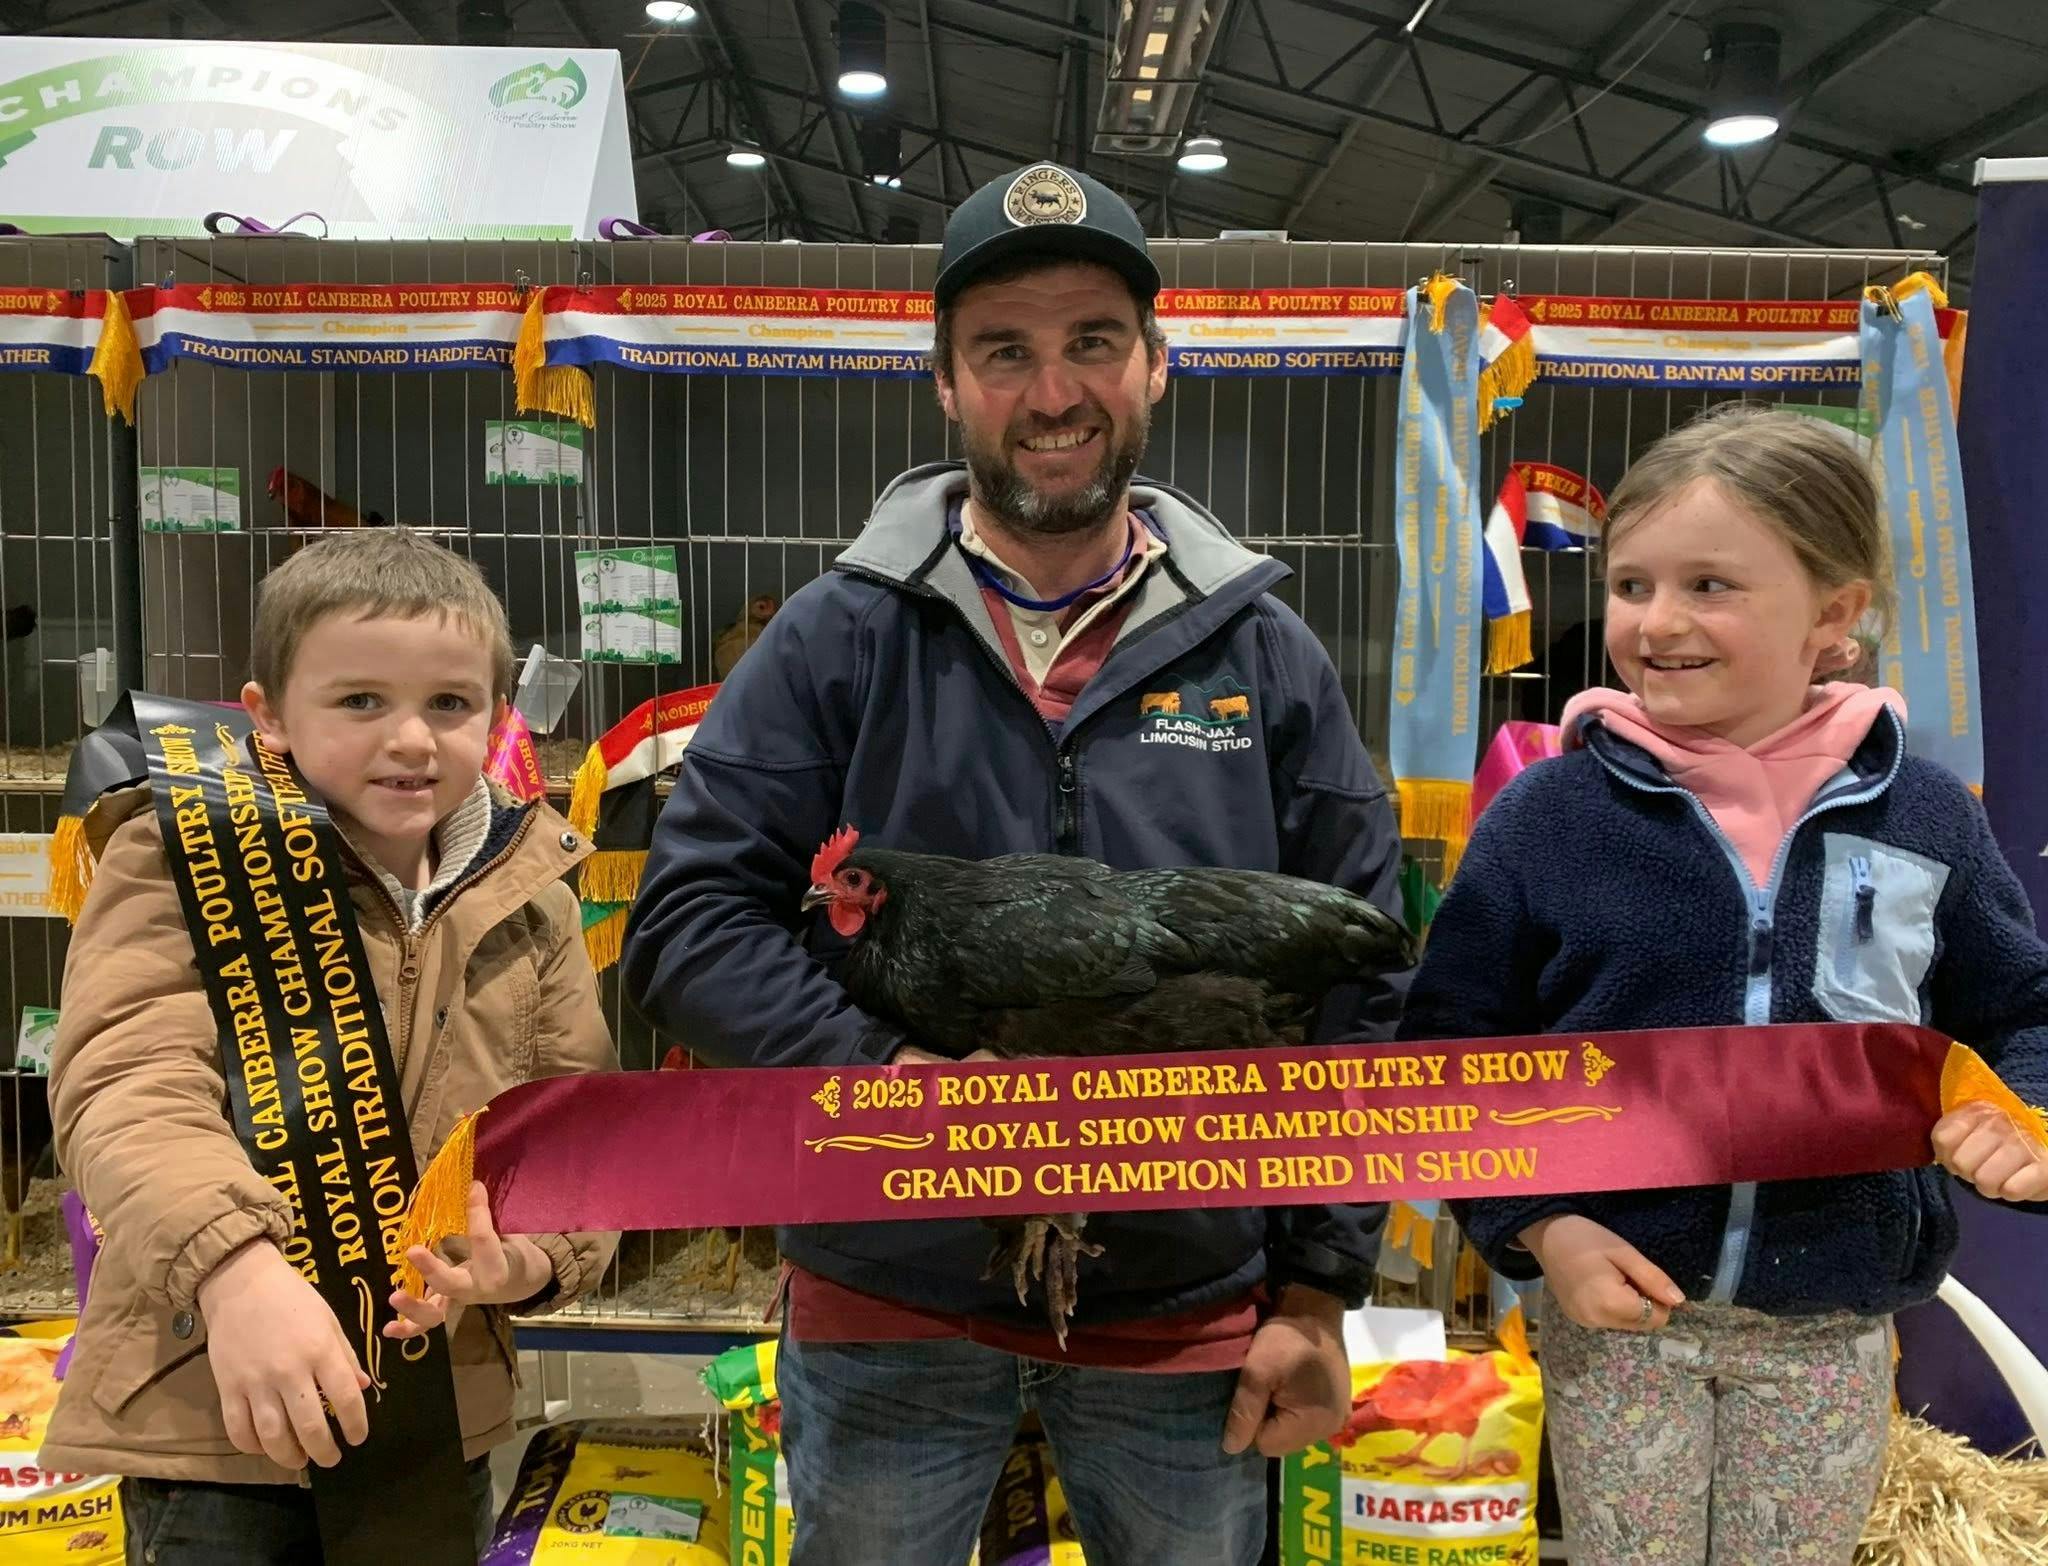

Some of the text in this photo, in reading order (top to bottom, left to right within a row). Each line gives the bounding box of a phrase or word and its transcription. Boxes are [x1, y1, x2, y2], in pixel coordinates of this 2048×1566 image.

[0, 67, 408, 131] CHAMPIONS
[88, 126, 298, 174] ROW
[1014, 169, 1077, 196] RINGERS
[1014, 206, 1078, 225] WESTERN
[215, 291, 522, 308] 2025 ROYAL CANBERRA POULTRY SHOW
[635, 293, 667, 309] 2025
[673, 294, 727, 310] ROYAL
[733, 295, 819, 312] CANBERRA
[826, 298, 899, 314] POULTRY
[1174, 295, 1262, 310] CANBERRA
[1268, 295, 1343, 311] POULTRY
[1348, 295, 1396, 311] SHOW
[1550, 303, 1583, 319] 2025
[1588, 304, 1646, 321] ROYAL
[1651, 306, 1739, 323] CANBERRA
[1746, 308, 1823, 324] POULTRY
[322, 320, 408, 337] Champion
[747, 322, 834, 341] Champion
[1188, 323, 1277, 340] Champion
[1662, 335, 1753, 352] Champion
[181, 339, 306, 365] TRADITIONAL
[311, 349, 409, 365] STANDARD
[618, 346, 742, 368] TRADITIONAL
[747, 352, 824, 369] BANTAM
[1179, 352, 1280, 368] STANDARD
[1534, 360, 1862, 382] TRADITIONAL BANTAM SOFTFEATH
[1404, 421, 1421, 494] POULTRY
[1533, 470, 1582, 497] PEKIN
[1431, 484, 1449, 574] Champion
[1907, 490, 1926, 578] Champion
[1455, 521, 1473, 616] STANDARD
[1936, 526, 1960, 607] BANTAM
[1451, 623, 1471, 736] TRADITIONAL
[1944, 613, 1969, 737] TRADITIONAL
[656, 698, 713, 723] MODER
[1140, 732, 1253, 752] LIMOUSIN STUD
[1155, 718, 1236, 739] FLASH-JAX
[159, 736, 199, 776] SHOW
[517, 738, 540, 785] SHOW
[171, 784, 241, 947] POULTRY
[223, 768, 368, 1267] ROYAL SHOW CHAMPIONSHIP
[303, 888, 391, 1151] TRADITIONAL
[220, 952, 289, 1151] CANBERRA
[853, 1050, 1570, 1110] 2025 ROYAL CANBERRA POULTRY SHOW
[946, 1104, 1480, 1152] ROYAL SHOW CHAMPIONSHIP
[882, 1146, 1539, 1201] GRAND CHAMPION BIRD IN SHOW
[366, 1156, 430, 1361] CPION
[37, 1495, 112, 1525] MASH
[1304, 1484, 1332, 1566] EN
[581, 1541, 603, 1549] NET
[1356, 1539, 1508, 1566] FREE RANGE
